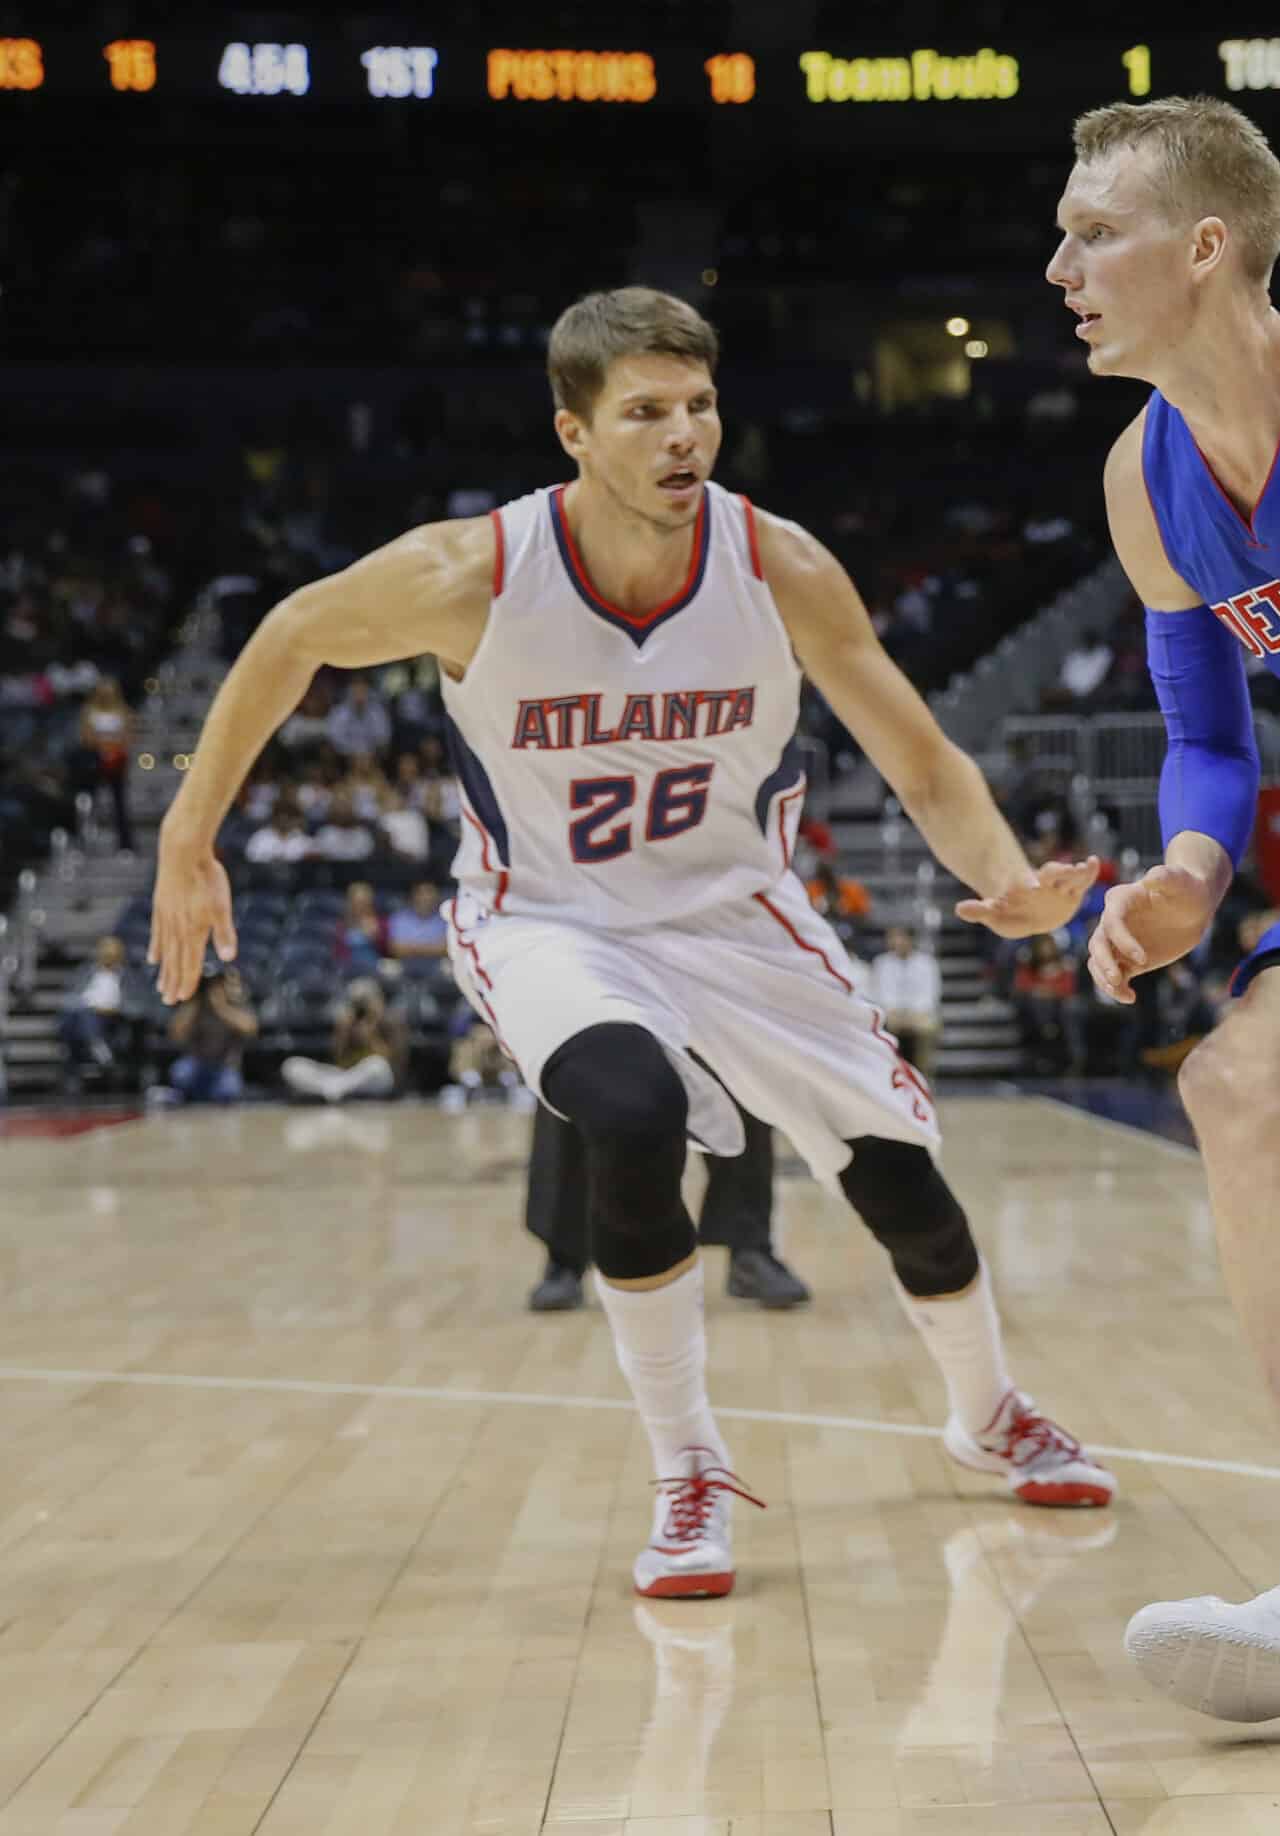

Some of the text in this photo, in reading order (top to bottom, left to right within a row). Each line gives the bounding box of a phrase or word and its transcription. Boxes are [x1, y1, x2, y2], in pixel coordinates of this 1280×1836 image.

[359, 46, 438, 98] 1ST
[488, 50, 656, 101] PISTONS
[800, 46, 1149, 102] Team Fouls 1
[511, 686, 756, 750] ATLANTA
[569, 762, 715, 864] 26
